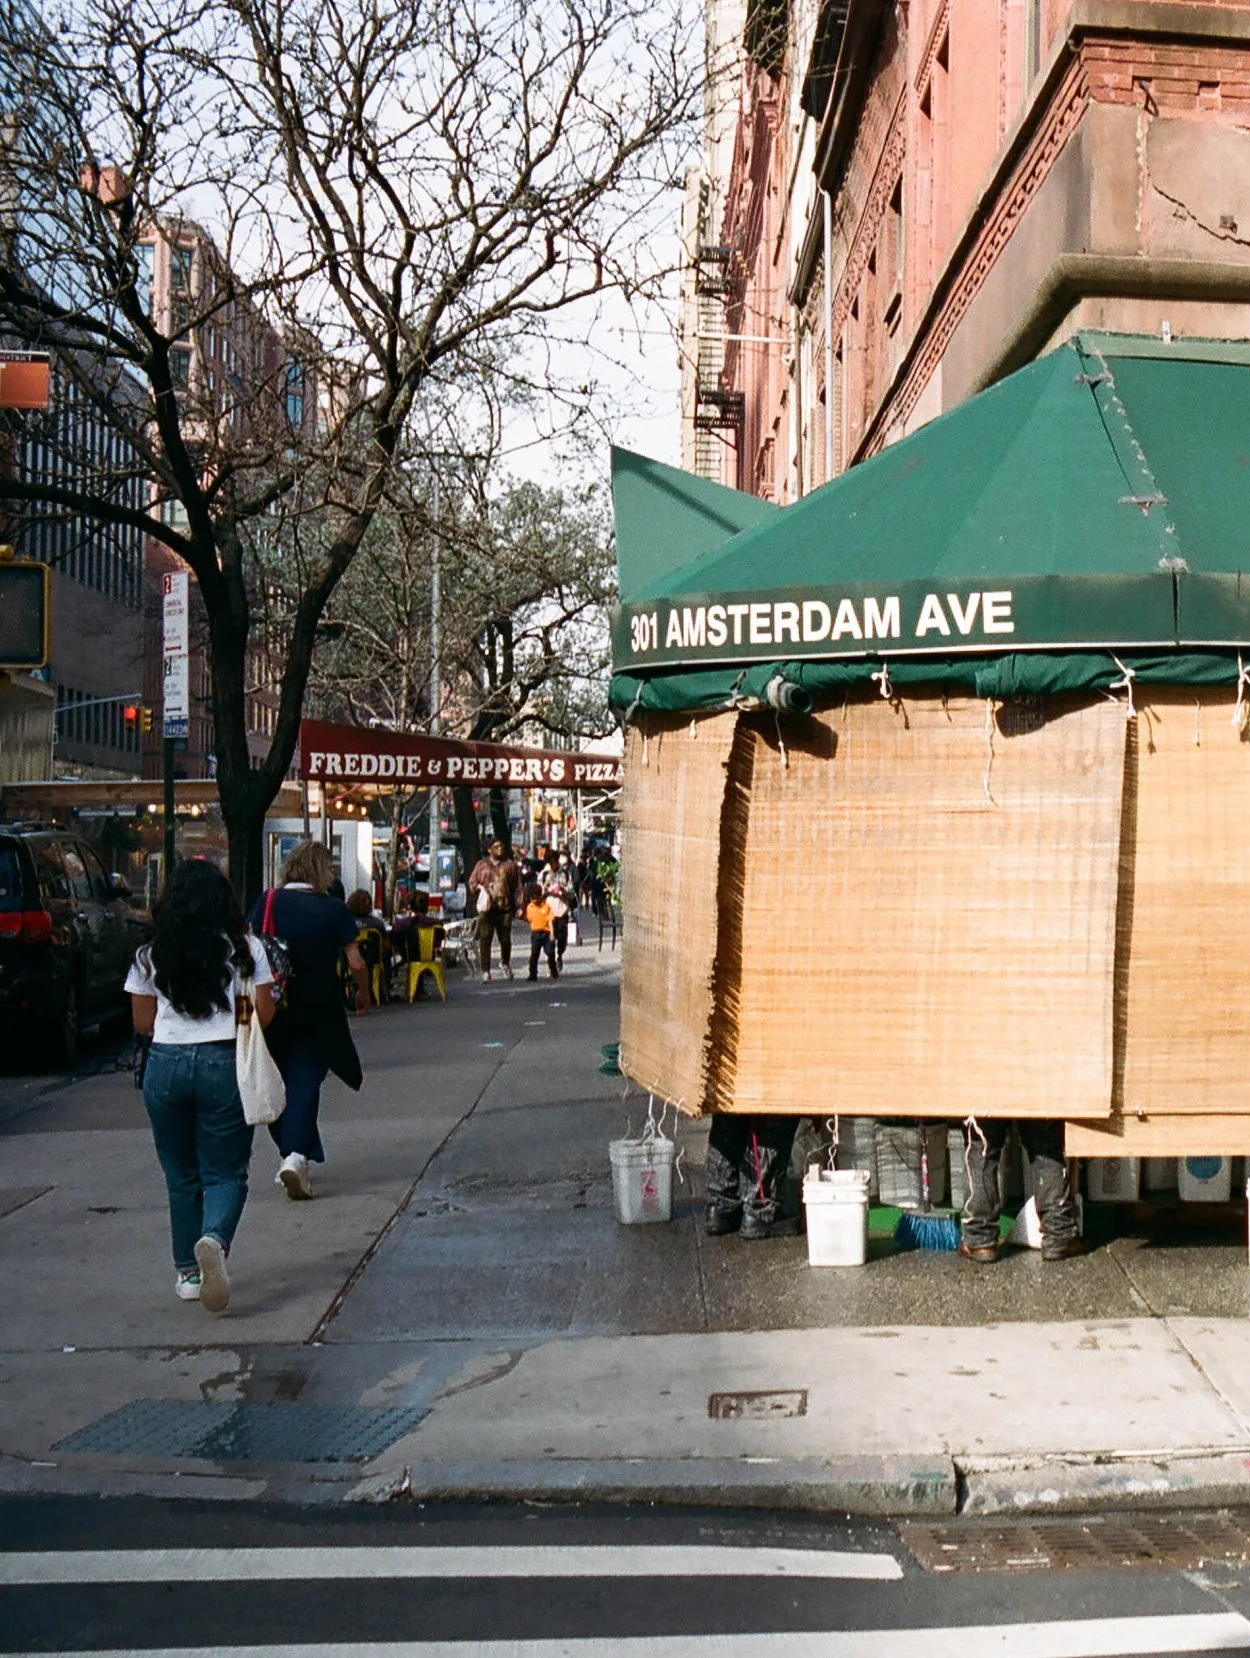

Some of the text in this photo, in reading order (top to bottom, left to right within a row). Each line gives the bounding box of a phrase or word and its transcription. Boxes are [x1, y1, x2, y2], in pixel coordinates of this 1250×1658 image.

[630, 590, 1015, 653] 301 AMSTERDAM AVE
[307, 752, 422, 777] FREDDIE
[427, 759, 442, 775] &
[446, 756, 565, 782] PEPPER'S
